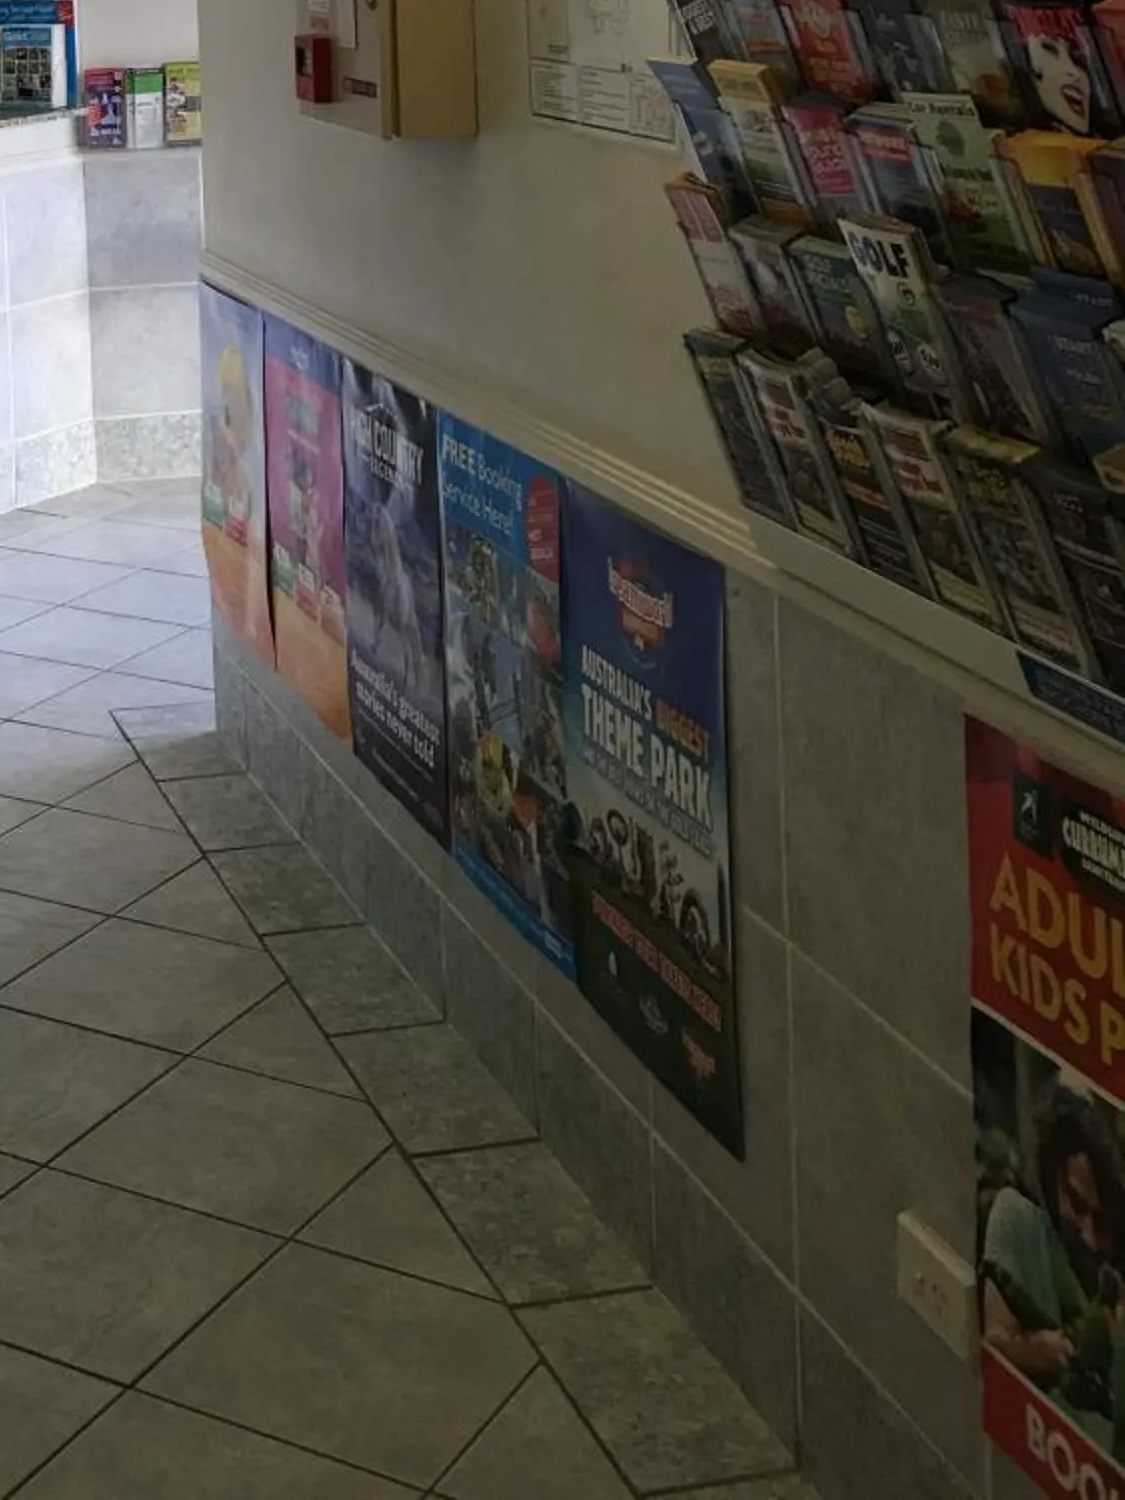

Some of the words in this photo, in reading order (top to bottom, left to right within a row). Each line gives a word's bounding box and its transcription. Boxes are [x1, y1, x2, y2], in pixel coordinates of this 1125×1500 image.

[849, 231, 910, 279] GOLF
[441, 432, 476, 476] FREE
[580, 682, 645, 780] THEME
[649, 733, 714, 835] PARK
[990, 921, 1092, 1047] KIDS
[1025, 1401, 1125, 1500] BOO
